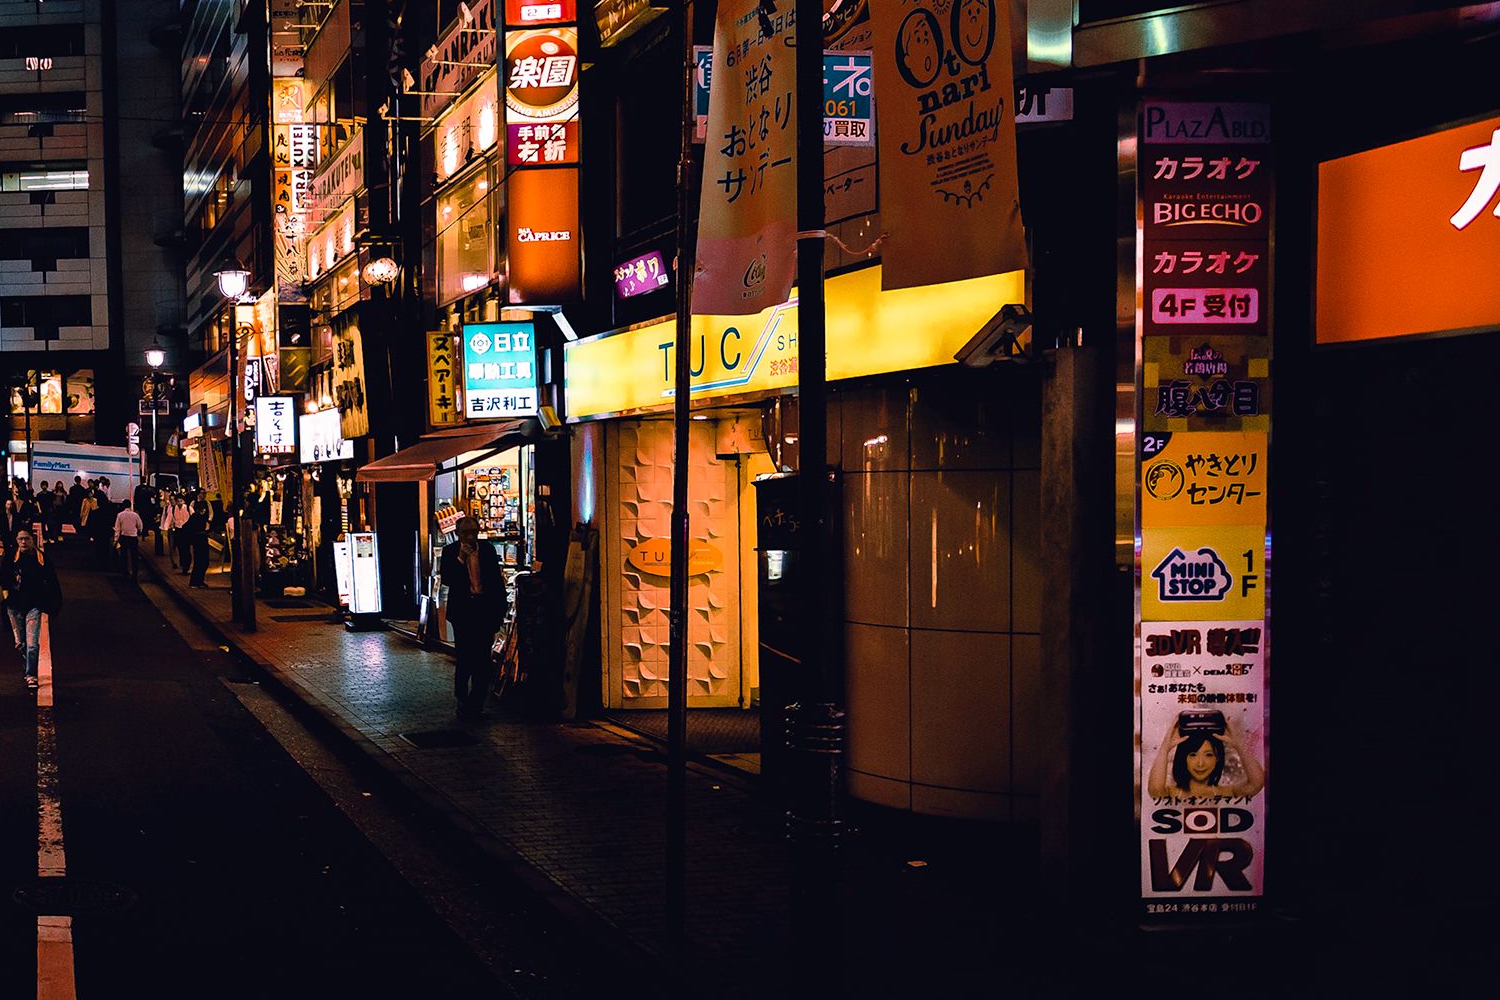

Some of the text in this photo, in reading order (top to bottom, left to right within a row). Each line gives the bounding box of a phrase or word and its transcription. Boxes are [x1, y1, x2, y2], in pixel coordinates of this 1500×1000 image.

[508, 55, 578, 90] 楽園
[744, 53, 773, 107] 渋谷
[517, 125, 567, 141] 手前角
[719, 92, 793, 160] おとなり
[900, 97, 1006, 156] Sunday
[517, 141, 567, 162] 右折
[716, 148, 792, 204] サンデー
[1152, 156, 1261, 182] カラオケ
[1153, 202, 1264, 226] BIG ECHO
[518, 231, 571, 244] CAPRICE
[1152, 251, 1260, 276] カラオケ
[1159, 294, 1252, 319] 4F 受付
[493, 331, 531, 353] 日立
[432, 336, 453, 422] スペアーキー
[470, 396, 532, 412] 吉沢利工
[1143, 436, 1165, 453] 2F
[33, 460, 71, 470] FamilyMart
[1184, 453, 1259, 478] やきとり
[1186, 483, 1262, 506] センター
[1170, 562, 1215, 579] MINI
[1168, 578, 1217, 596] STOP
[1145, 629, 1202, 657] 3DVR
[1150, 807, 1255, 835] SOD
[1148, 837, 1254, 893] VR
